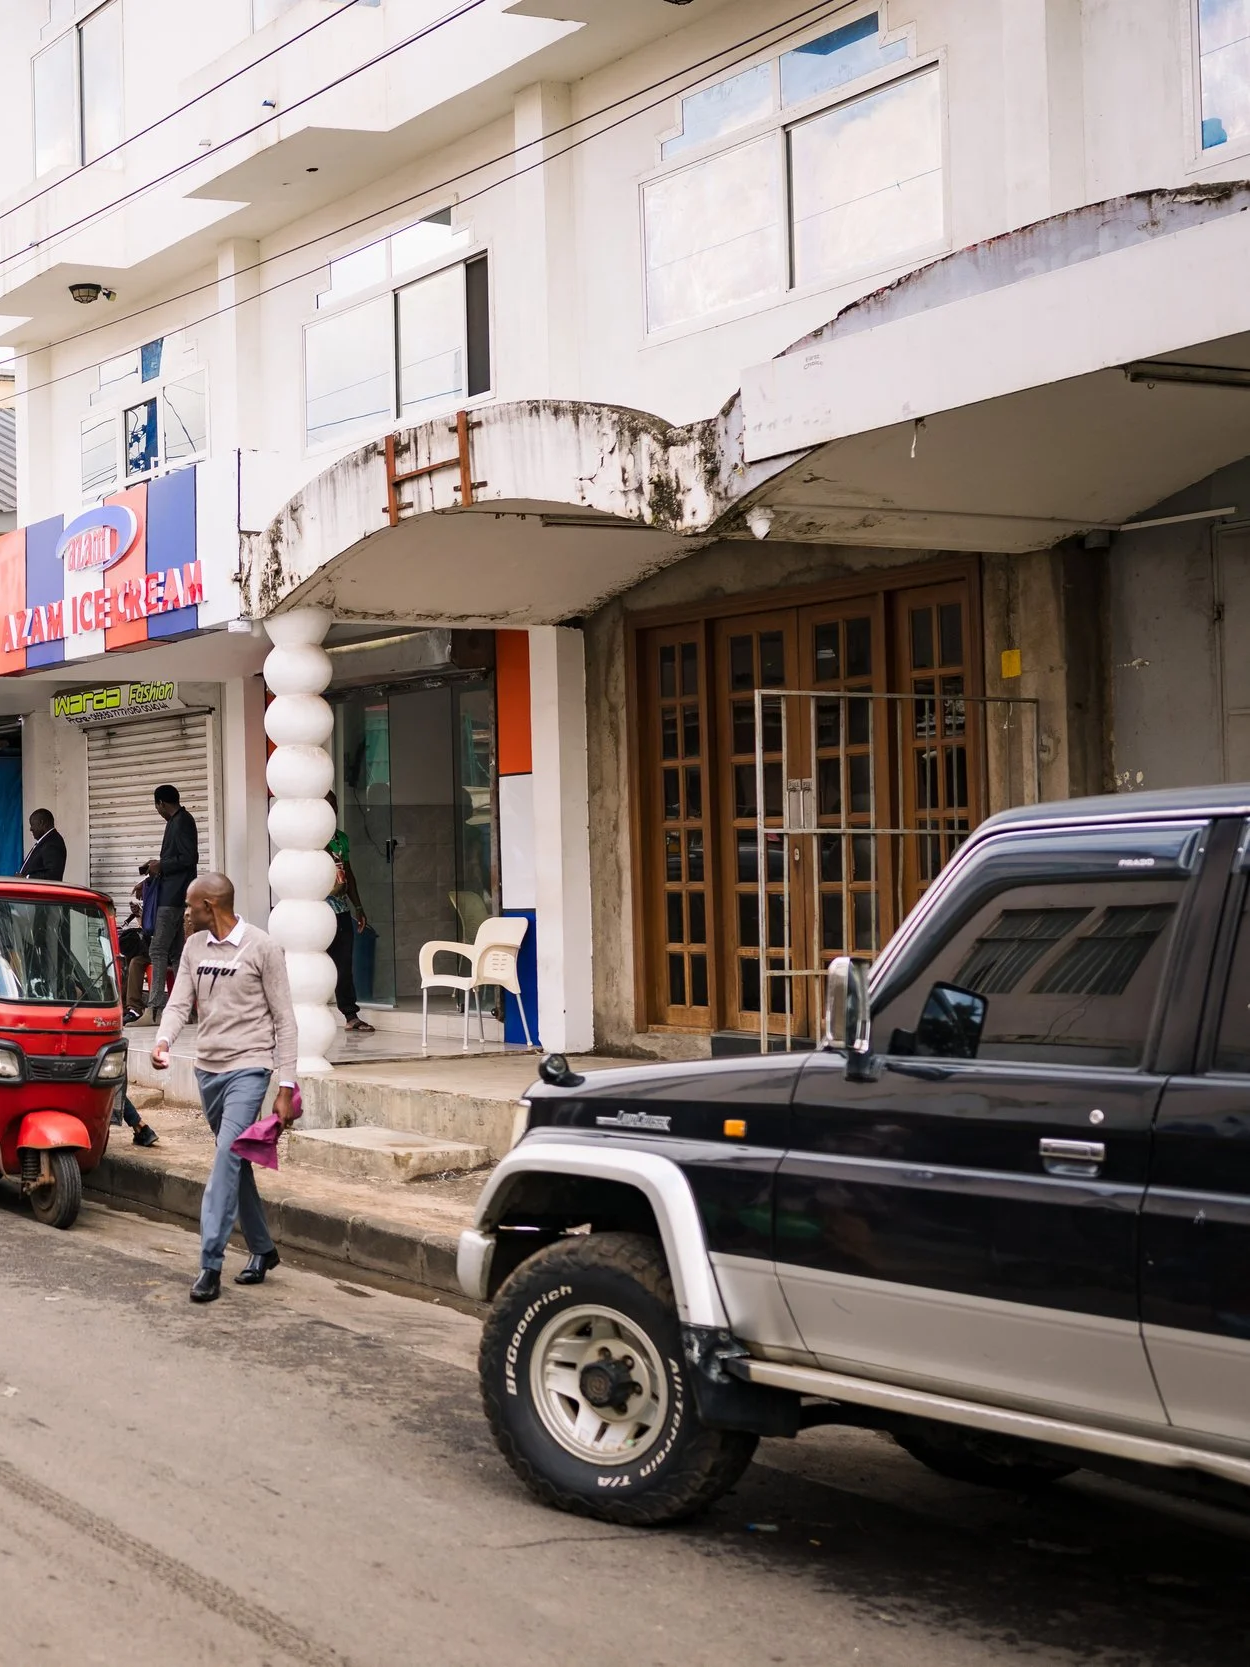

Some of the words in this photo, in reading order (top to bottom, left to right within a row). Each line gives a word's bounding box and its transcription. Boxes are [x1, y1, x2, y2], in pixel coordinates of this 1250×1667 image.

[3, 599, 65, 652] AZAM
[71, 588, 113, 635] ICE
[116, 560, 203, 622] CREAM
[128, 681, 174, 706] Fashion
[505, 1285, 573, 1396] BFGoodrich
